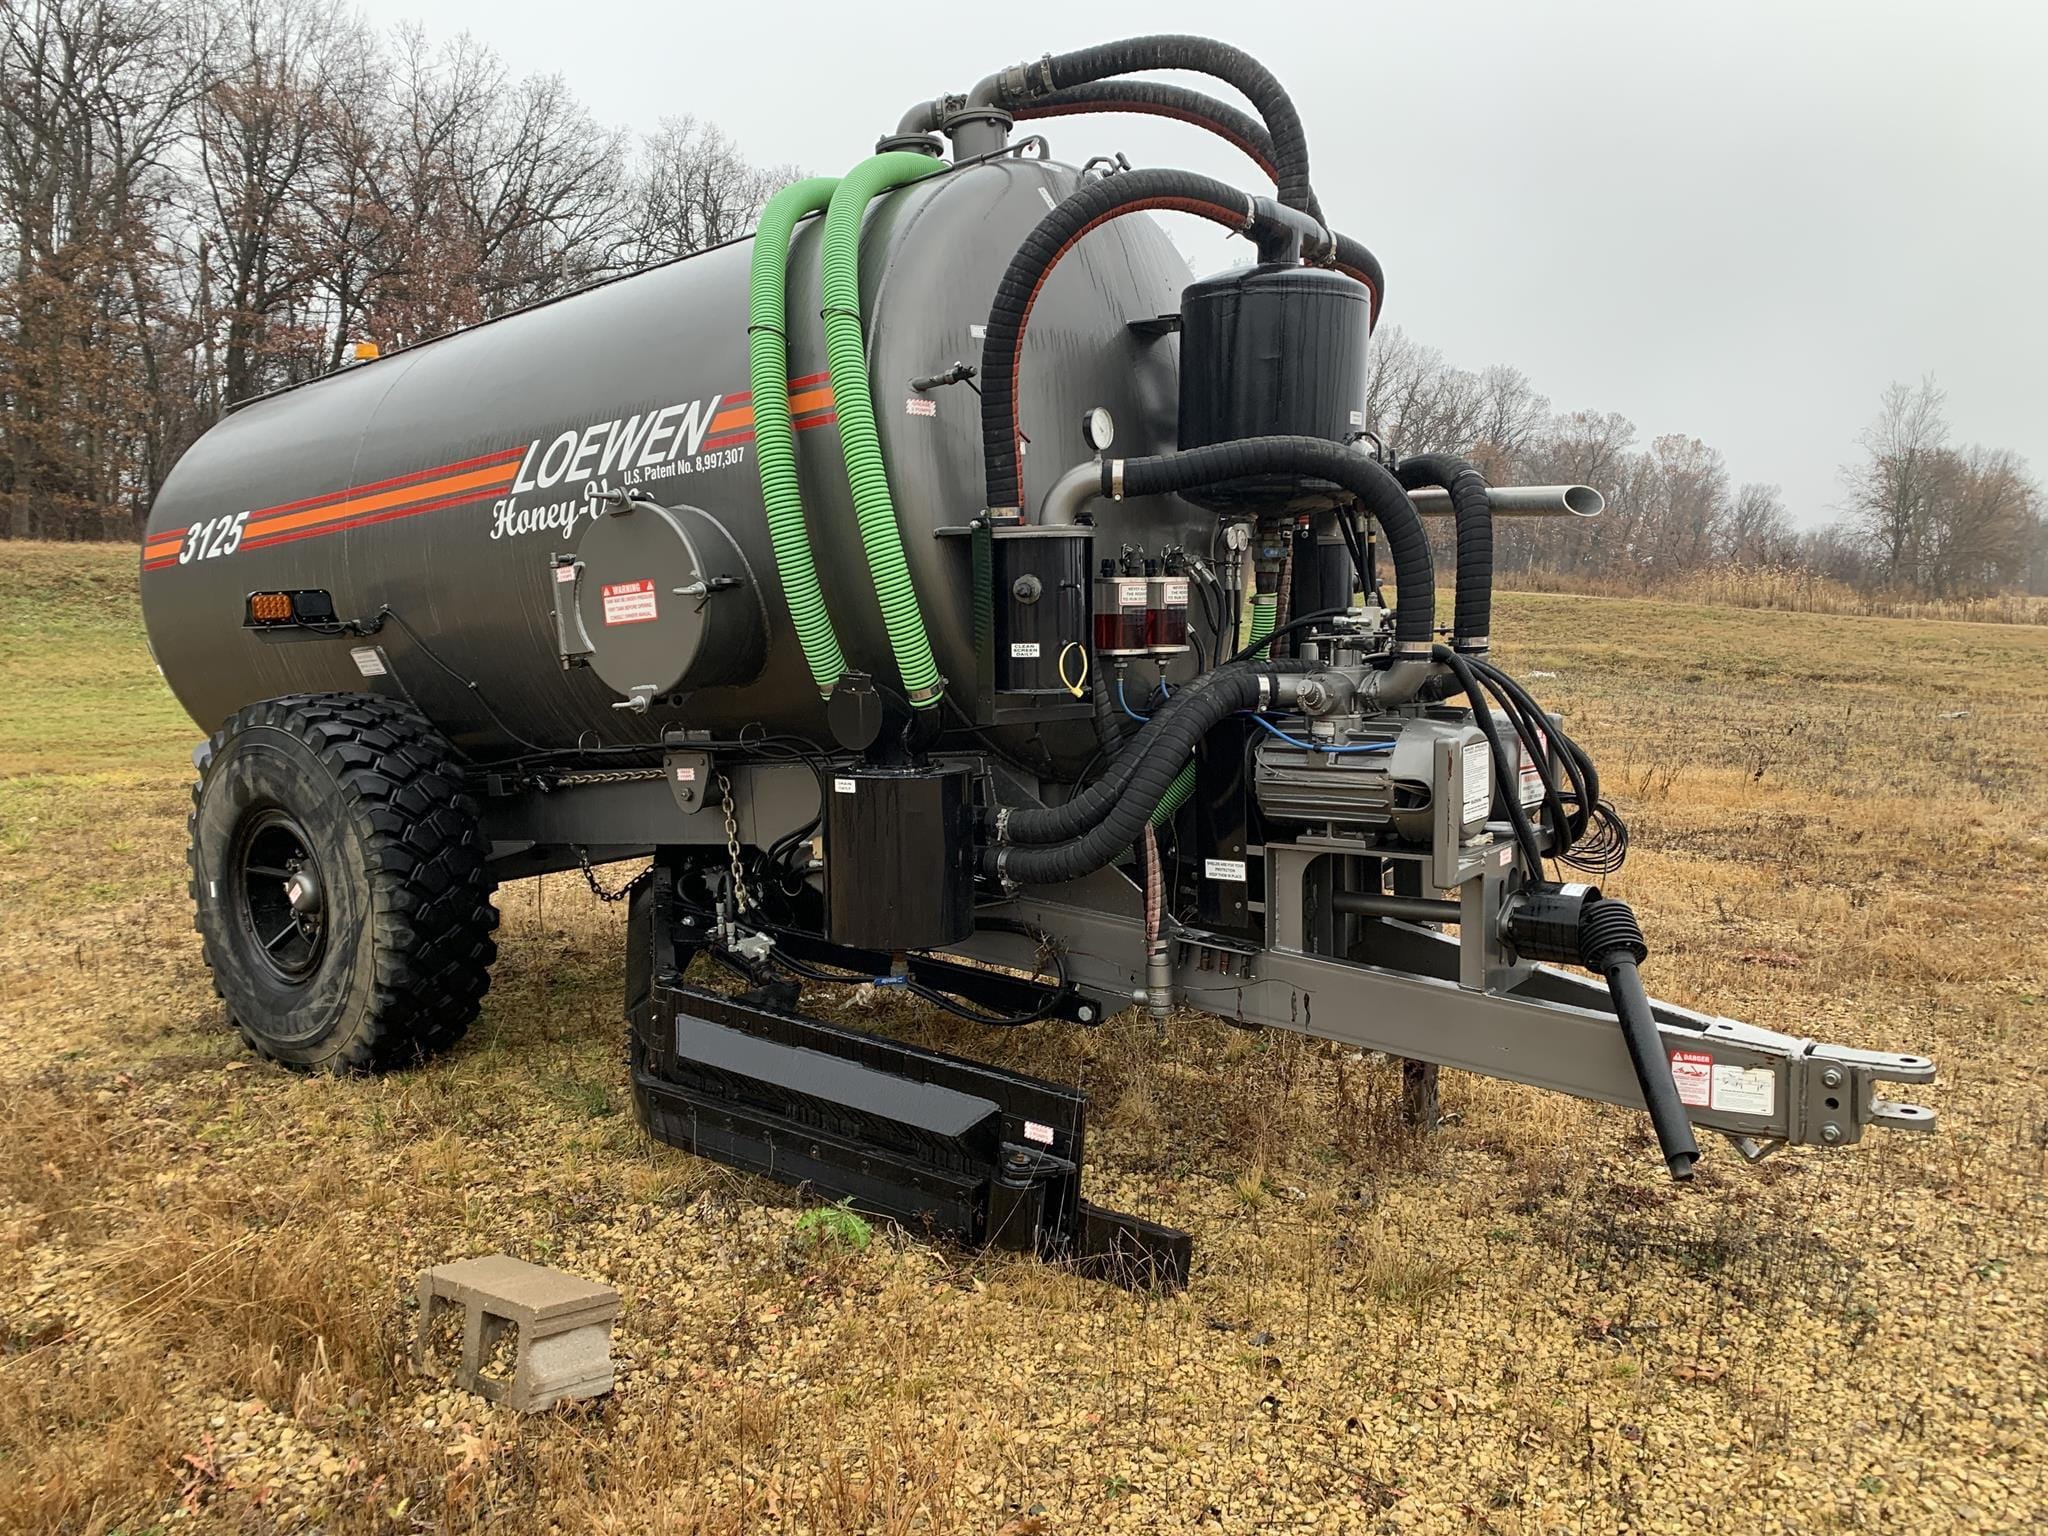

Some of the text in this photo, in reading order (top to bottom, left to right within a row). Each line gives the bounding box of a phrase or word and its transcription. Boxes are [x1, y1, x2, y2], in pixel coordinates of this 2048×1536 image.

[512, 395, 721, 494] LOEWEN
[624, 446, 744, 485] U.S. Patent No. 8,997,307
[179, 511, 250, 565] 3125
[612, 582, 641, 595] WARNING
[1683, 1053, 1710, 1063] DANGER
